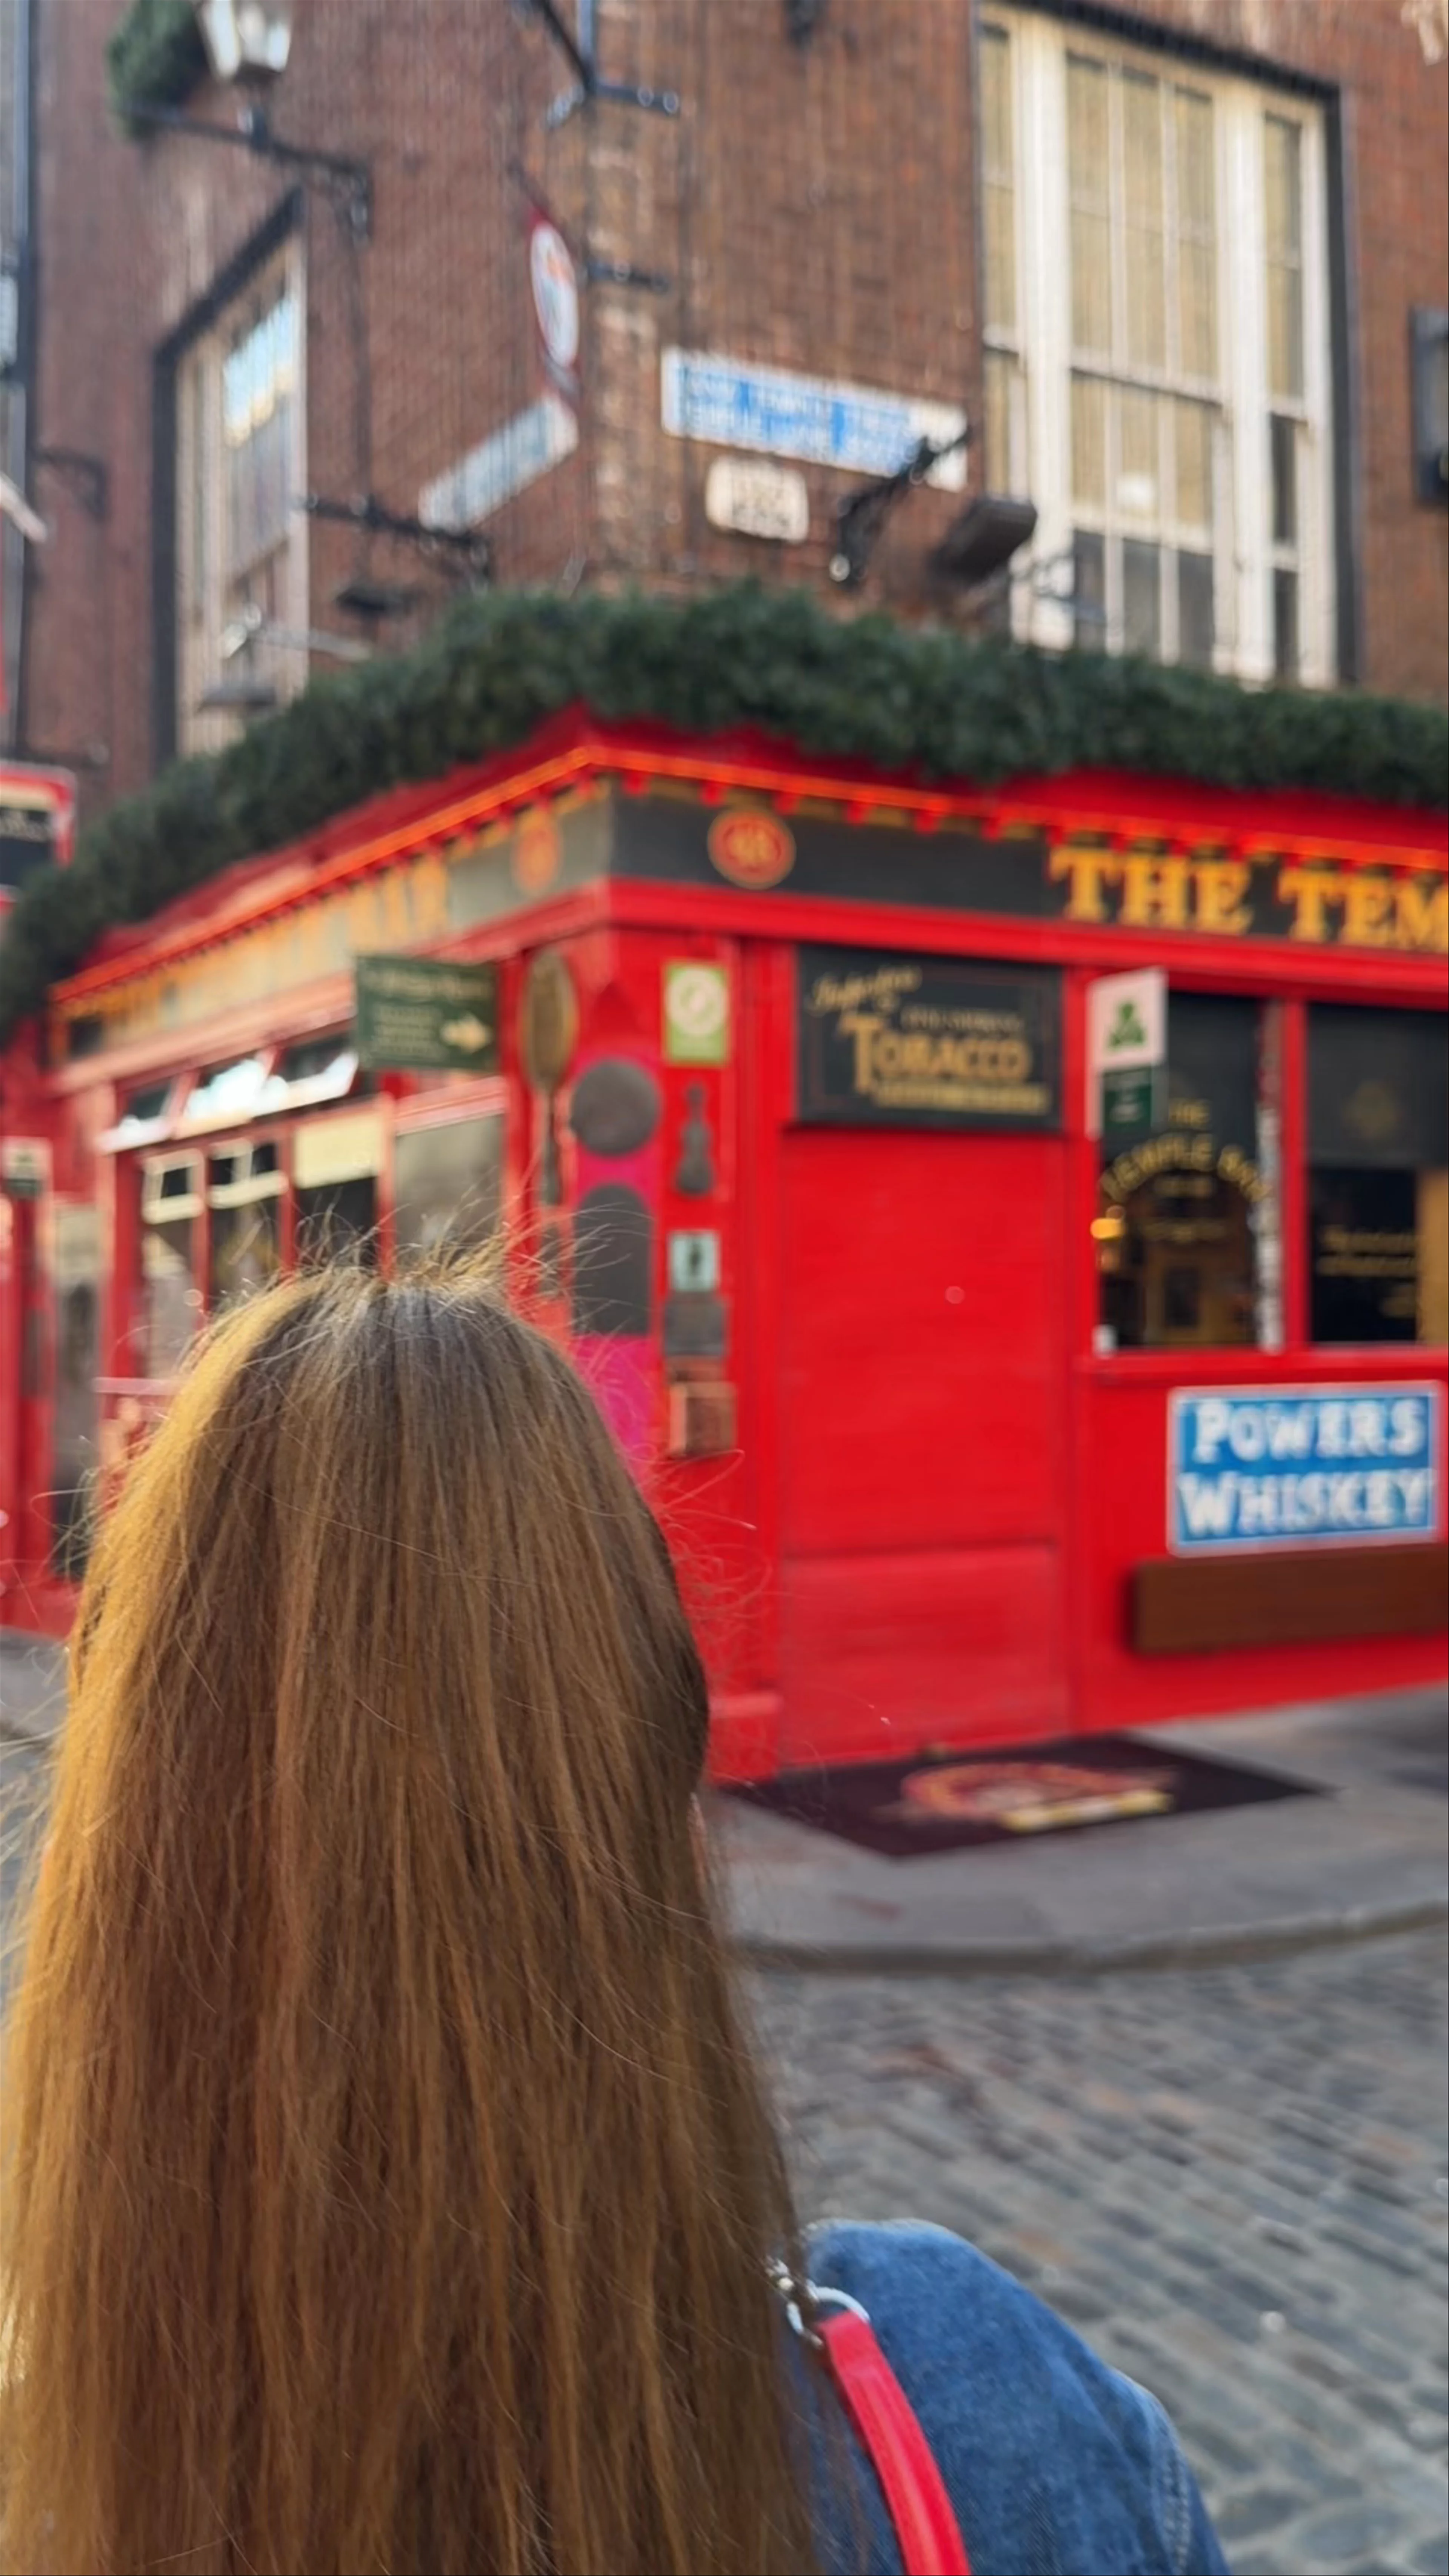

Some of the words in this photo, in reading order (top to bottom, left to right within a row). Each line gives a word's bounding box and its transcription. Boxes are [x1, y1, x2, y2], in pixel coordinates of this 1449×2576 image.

[1050, 848, 1254, 936] THE
[1192, 1397, 1427, 1464] POWERS
[1177, 1468, 1436, 1536] WHISKEY
